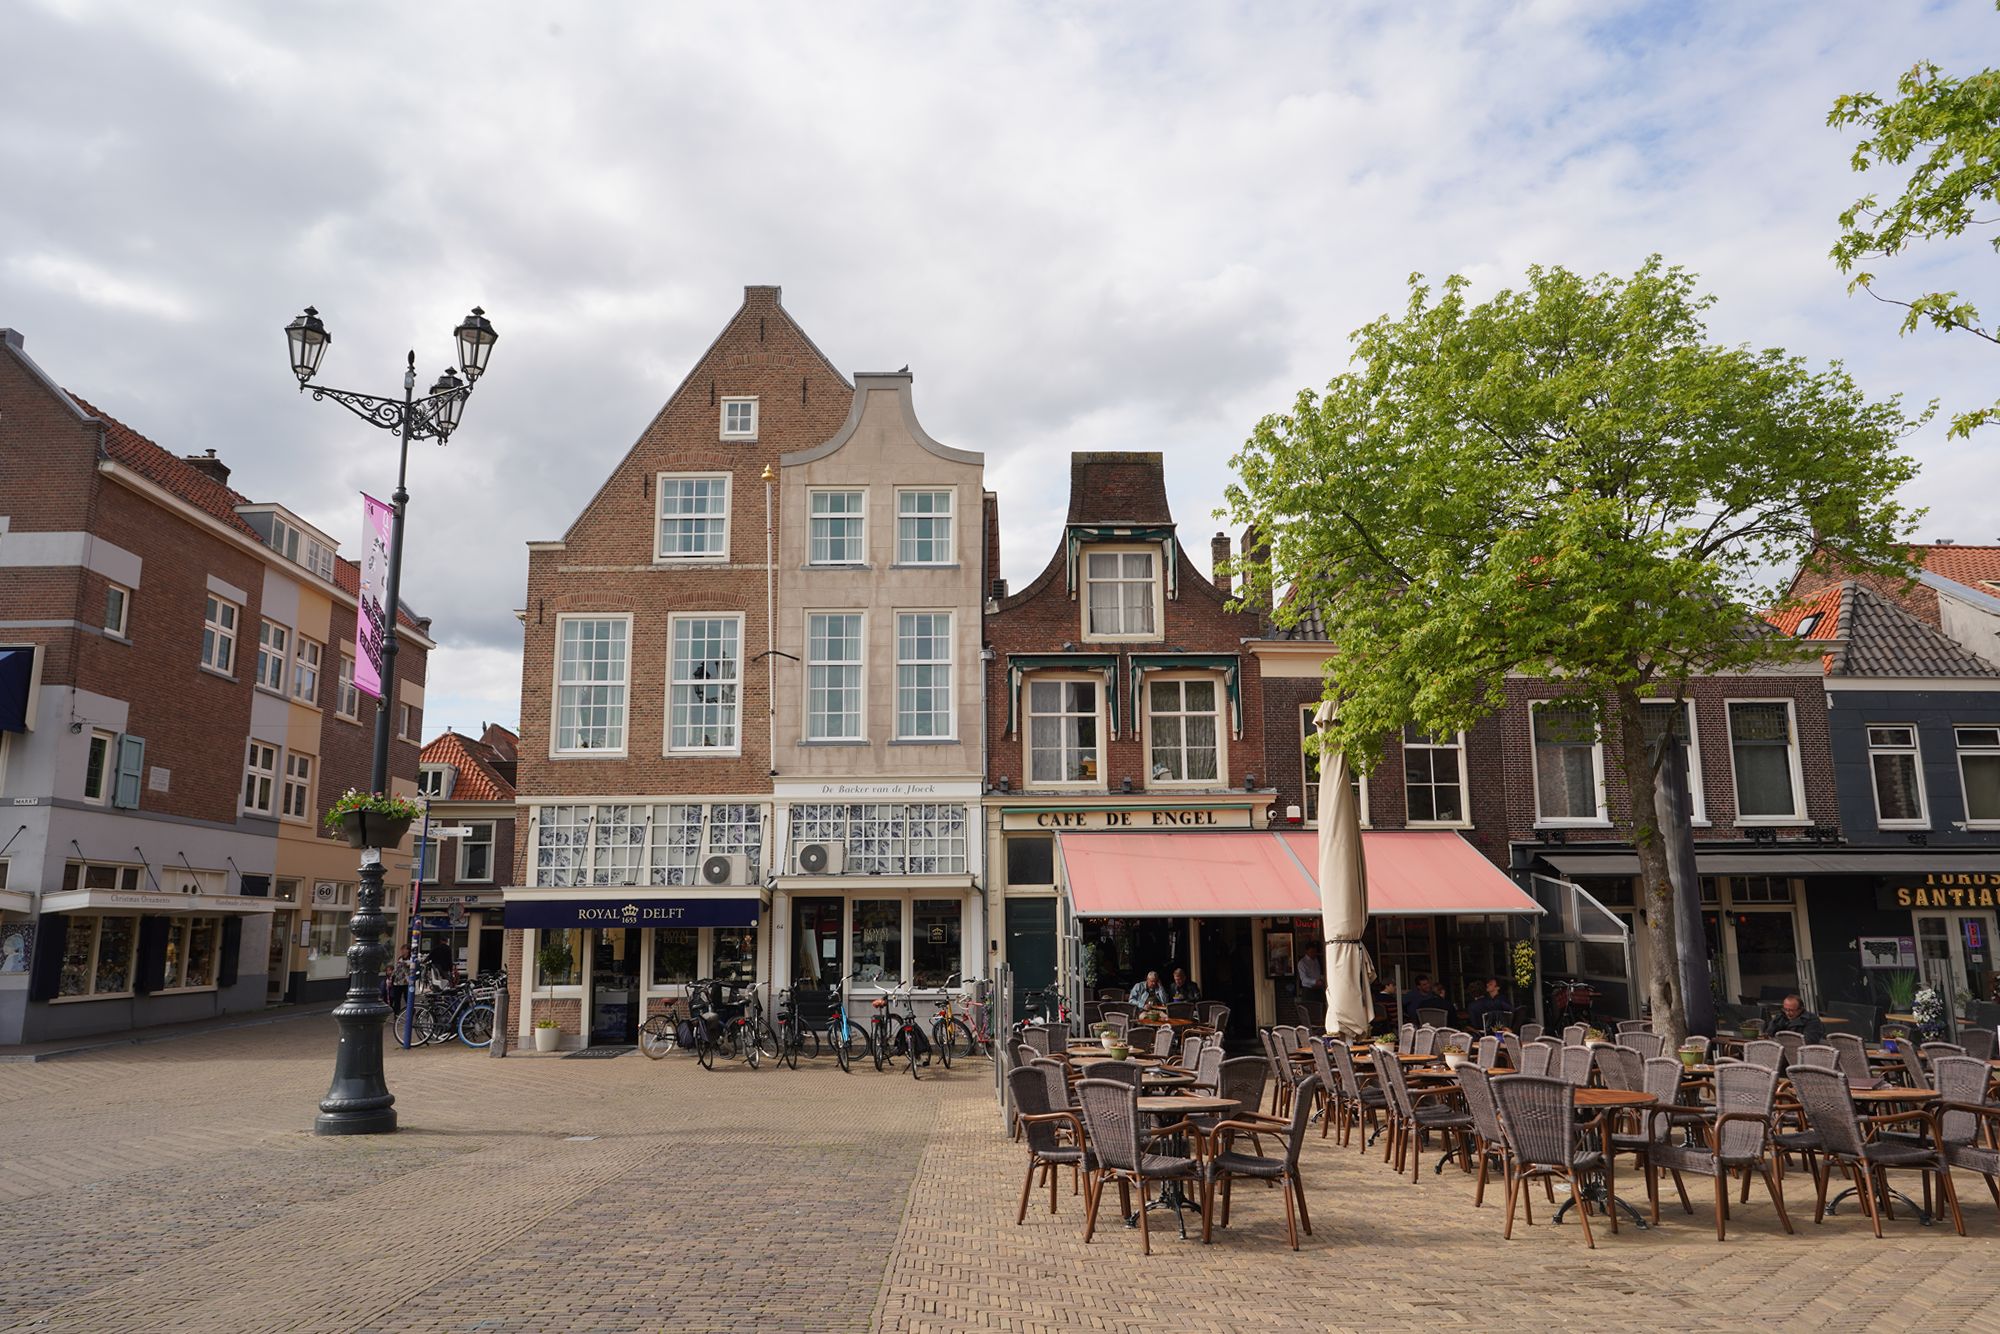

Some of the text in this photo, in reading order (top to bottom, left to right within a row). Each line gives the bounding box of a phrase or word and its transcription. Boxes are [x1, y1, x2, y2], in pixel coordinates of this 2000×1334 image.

[822, 784, 834, 794] De
[872, 786, 889, 794] van
[892, 784, 903, 794] de
[1037, 811, 1217, 827] CAFE DE ENGEL
[319, 887, 331, 895] 60
[578, 908, 685, 920] ROYAL DELFT
[622, 916, 637, 924] 1653
